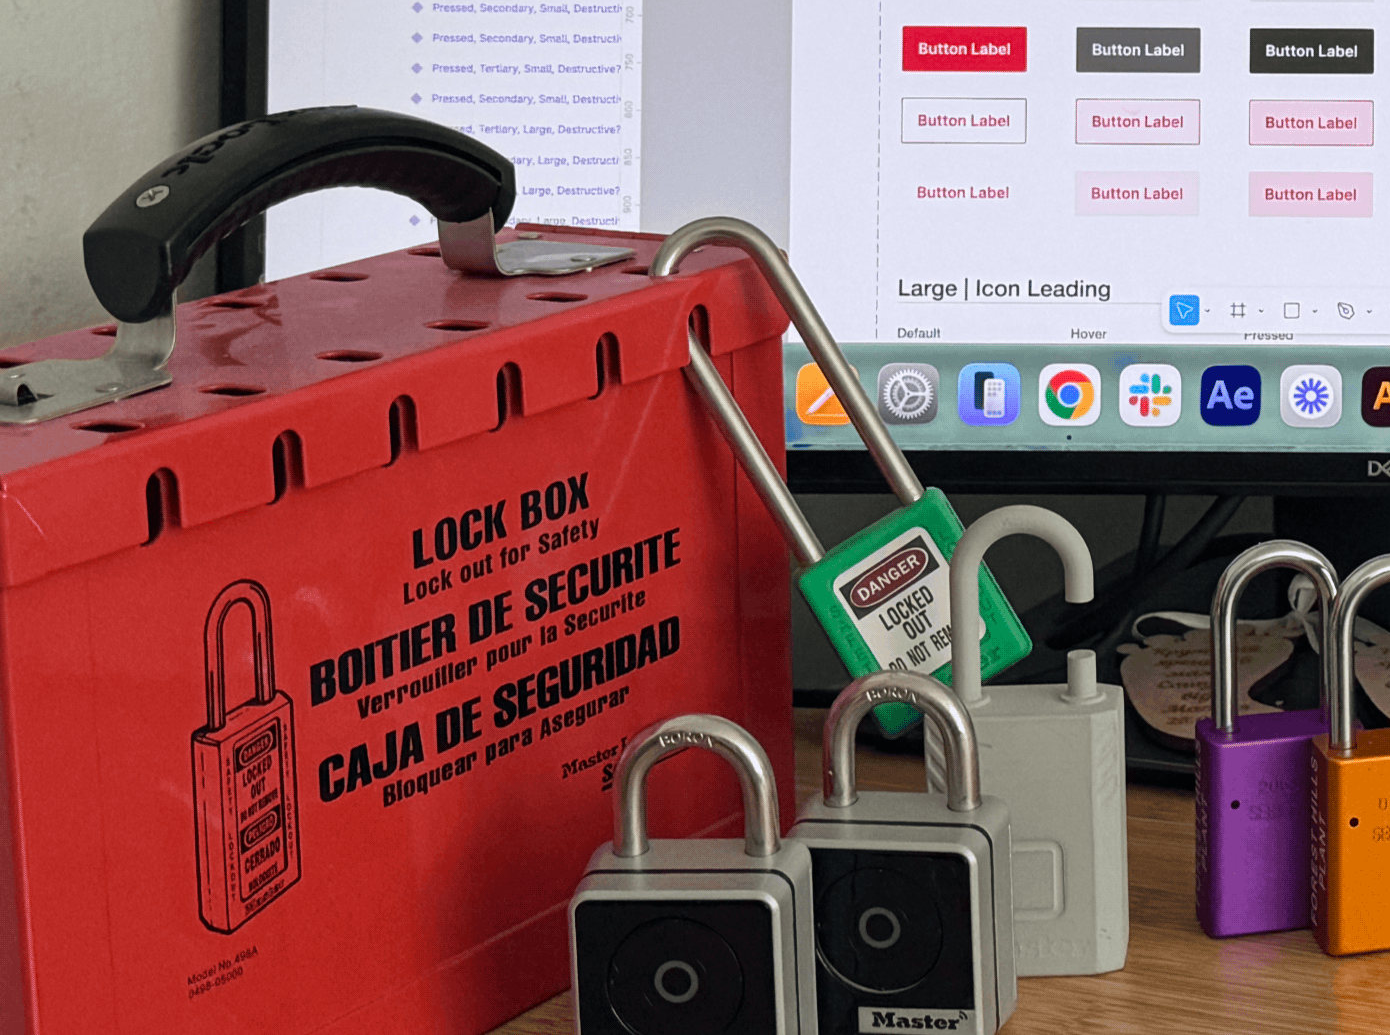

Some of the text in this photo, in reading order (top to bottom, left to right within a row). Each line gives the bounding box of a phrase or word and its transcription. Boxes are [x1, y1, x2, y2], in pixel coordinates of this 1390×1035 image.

[919, 43, 1010, 55] Button Label
[899, 279, 1110, 301] Large Icon Leading
[898, 328, 940, 338] Default
[1071, 328, 1107, 339] Hover
[1207, 380, 1254, 410] Ae
[412, 472, 590, 569] LOCK BOX
[403, 517, 599, 604] Lock out for Safety
[857, 554, 920, 602] DANGER
[310, 528, 681, 706] BOITIER DE SECURITE
[879, 586, 934, 631] LOCKED
[902, 610, 933, 640] OUT
[356, 589, 646, 719] Verrouiller pour la Securite
[906, 642, 932, 666] NOT
[318, 727, 422, 803] CAJA
[436, 695, 481, 754] DE
[493, 616, 681, 728] SEGURIDAD
[866, 688, 918, 702] BORON
[383, 685, 630, 807] Bloquear para Asegurar
[562, 744, 619, 779] Master
[1310, 756, 1318, 926] FOREST HILLS
[1318, 811, 1326, 890] PLANT
[872, 1012, 960, 1030] Master
